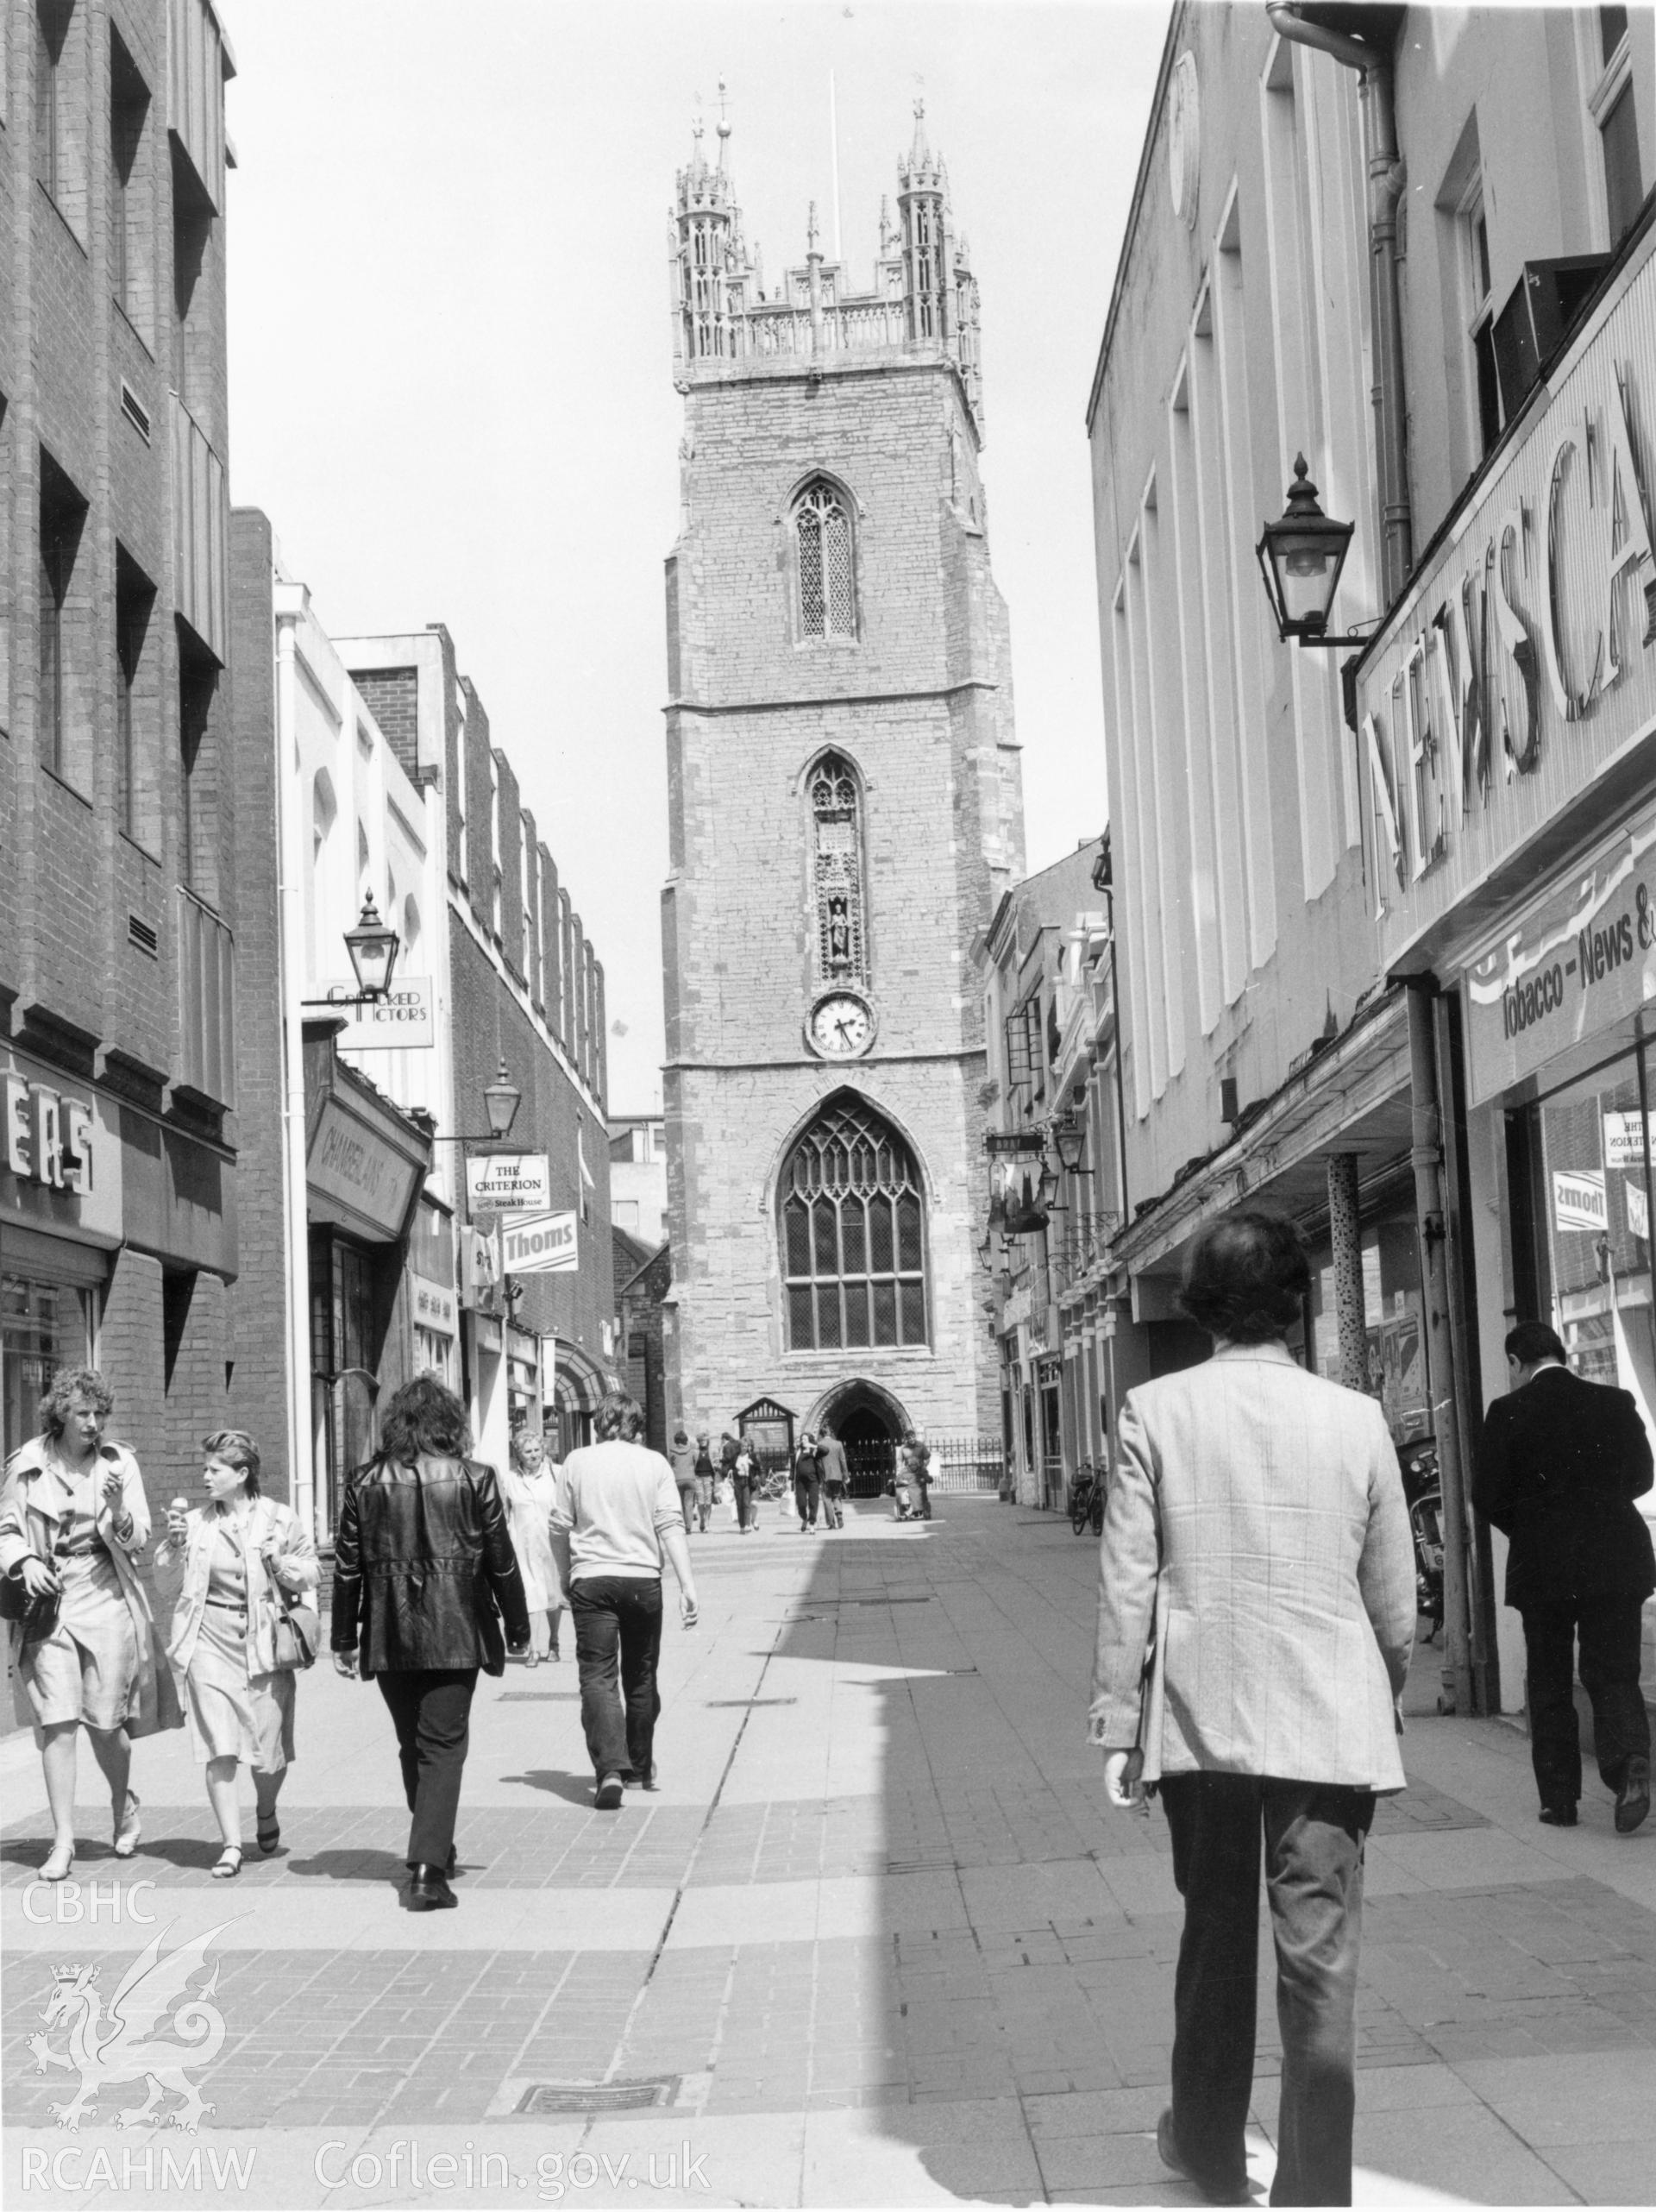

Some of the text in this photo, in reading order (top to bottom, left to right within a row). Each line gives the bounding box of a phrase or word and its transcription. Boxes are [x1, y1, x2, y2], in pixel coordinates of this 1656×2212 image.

[1503, 976, 1563, 1040] Tobacco
[1579, 913, 1633, 990] News
[496, 1166, 520, 1177] THE
[475, 1179, 542, 1191] CRITERION
[495, 1198, 518, 1208] Steak
[518, 1197, 543, 1206] House
[505, 1223, 574, 1261] Thoms
